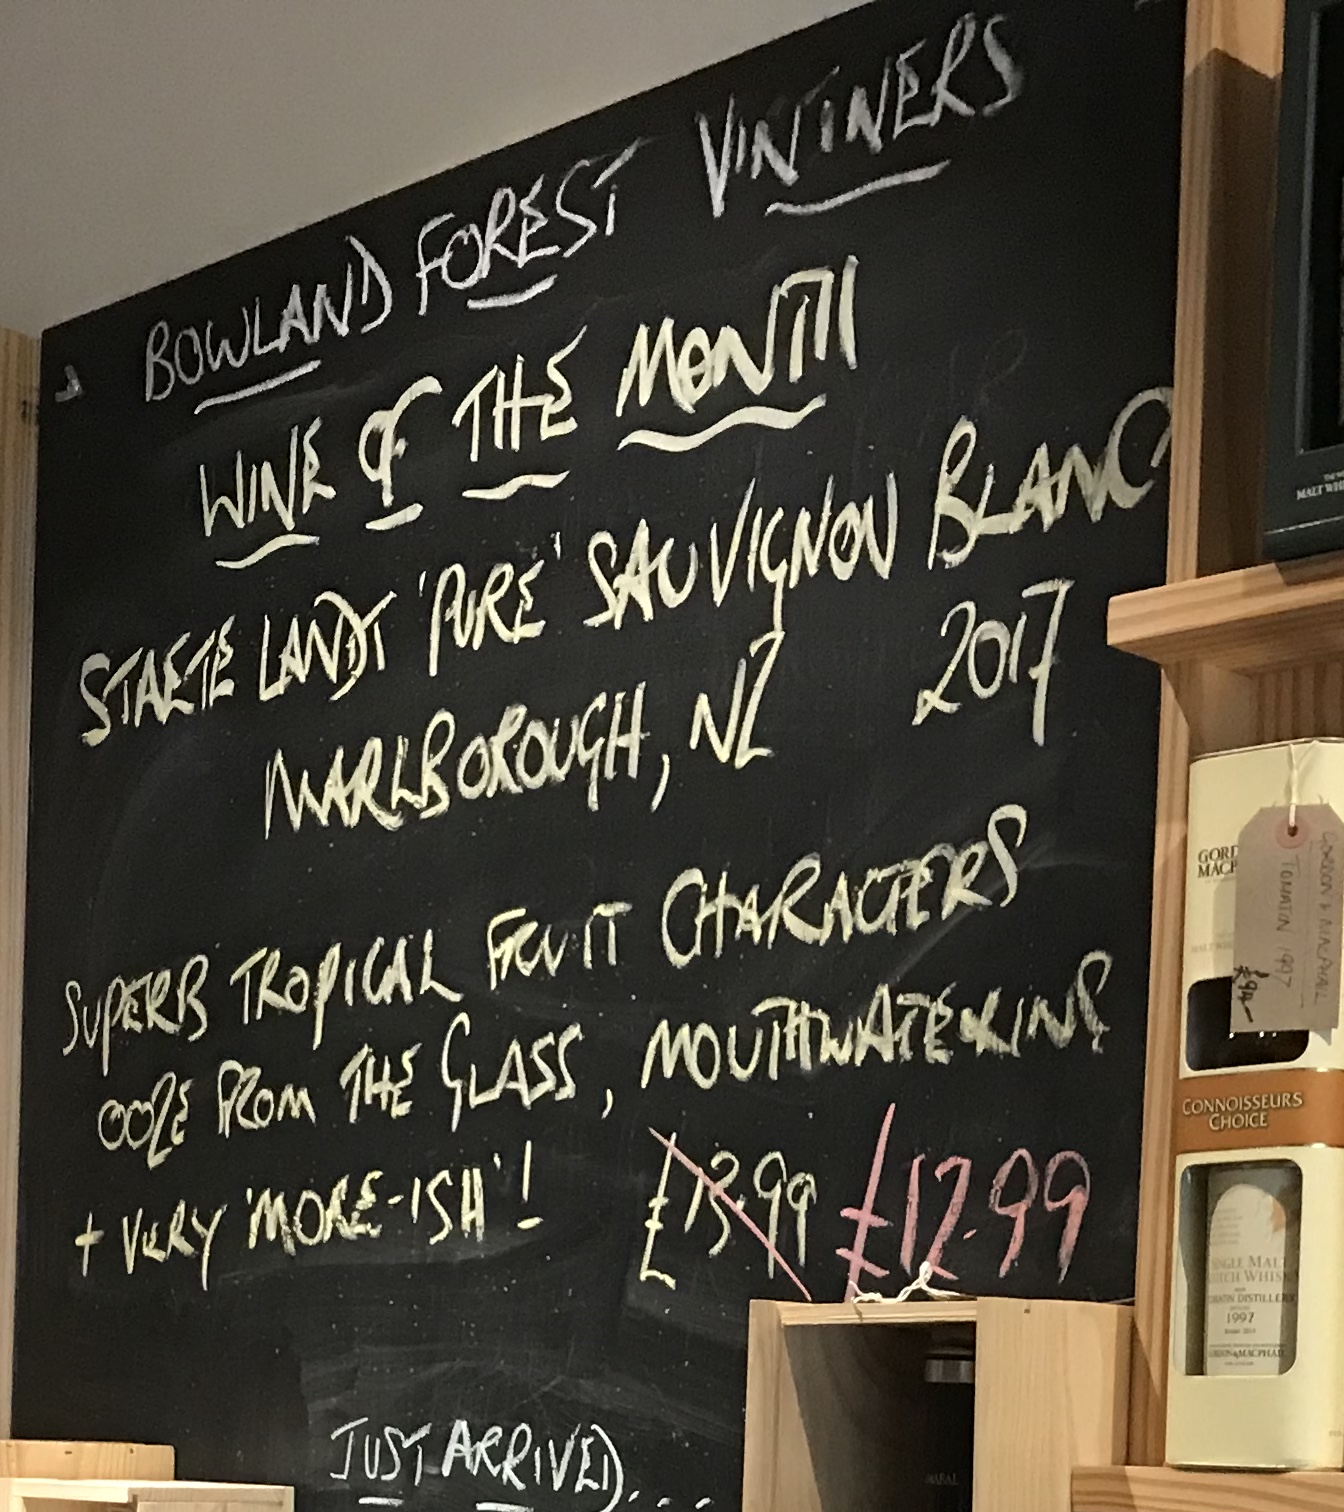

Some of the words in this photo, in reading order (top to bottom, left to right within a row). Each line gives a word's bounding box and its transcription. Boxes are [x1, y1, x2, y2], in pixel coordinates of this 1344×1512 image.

[145, 236, 393, 401] BOWLAND
[418, 138, 653, 314] FOREST
[200, 415, 337, 539] WINE
[453, 325, 589, 464] THE
[617, 255, 860, 420] MONTH
[584, 470, 898, 636] SAUVIGNON
[927, 388, 1174, 570] BLANC
[263, 680, 672, 842] MARLBOROUGH,
[690, 630, 787, 764] NZ
[910, 578, 1074, 745] 2017
[1198, 844, 1239, 864] GORD
[1198, 860, 1239, 878] MACP
[1276, 854, 1301, 932] TOMATIN
[62, 953, 210, 1060] SUPERB
[229, 933, 465, 1052] TROPICAL
[486, 900, 633, 994] FRUIT
[662, 803, 1029, 970] CHARACTERS
[1274, 946, 1296, 989] 1997
[214, 1057, 316, 1137] FROM
[339, 1040, 423, 1125] THE
[1182, 1090, 1304, 1117] CONNOISSEURS
[1208, 1112, 1269, 1132] CHOICE
[120, 1199, 229, 1292] VERY
[1226, 1311, 1255, 1324] 1997
[330, 1417, 432, 1487] JUST
